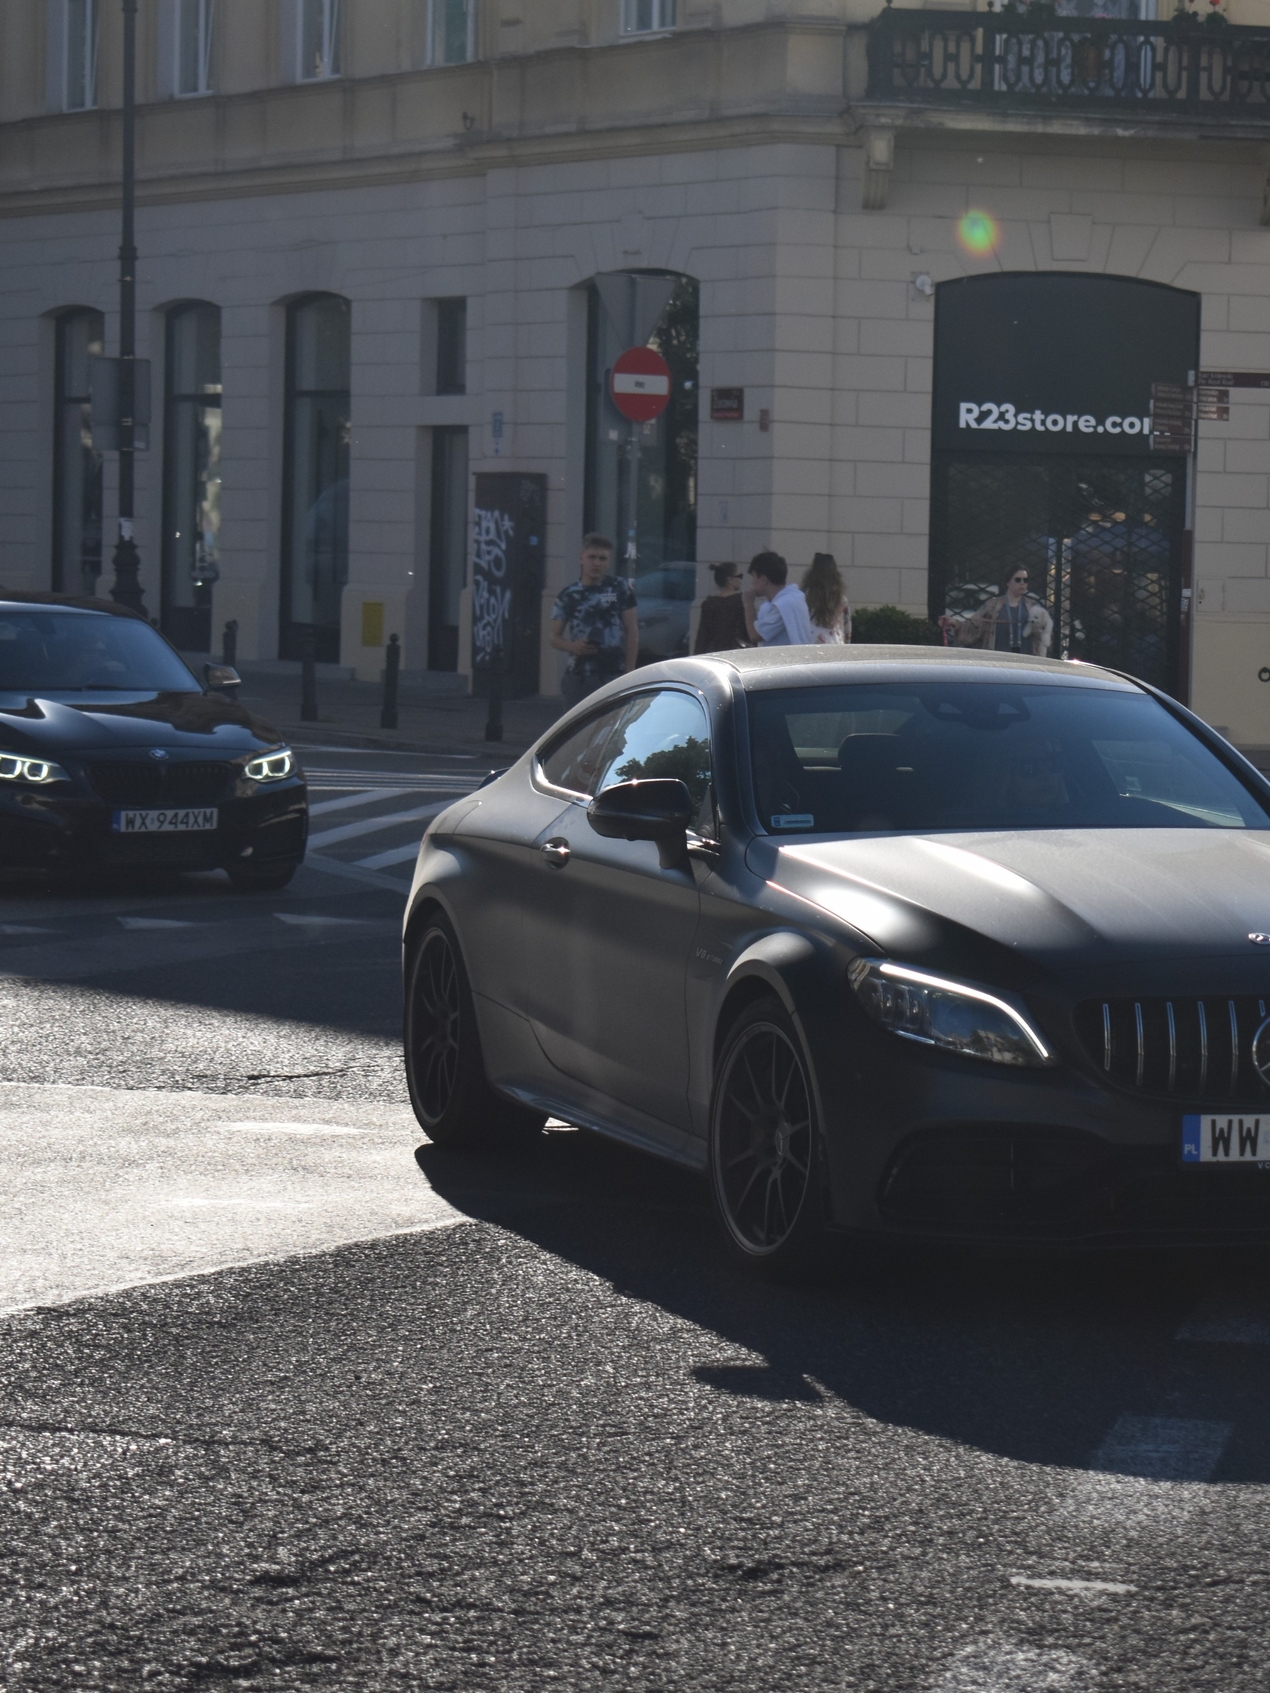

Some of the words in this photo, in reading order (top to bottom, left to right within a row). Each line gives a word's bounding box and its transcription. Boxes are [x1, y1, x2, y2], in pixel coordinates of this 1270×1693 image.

[125, 812, 149, 831] WX
[157, 810, 214, 830] 944XM
[1210, 1118, 1260, 1157] WW
[1184, 1144, 1198, 1155] PL
